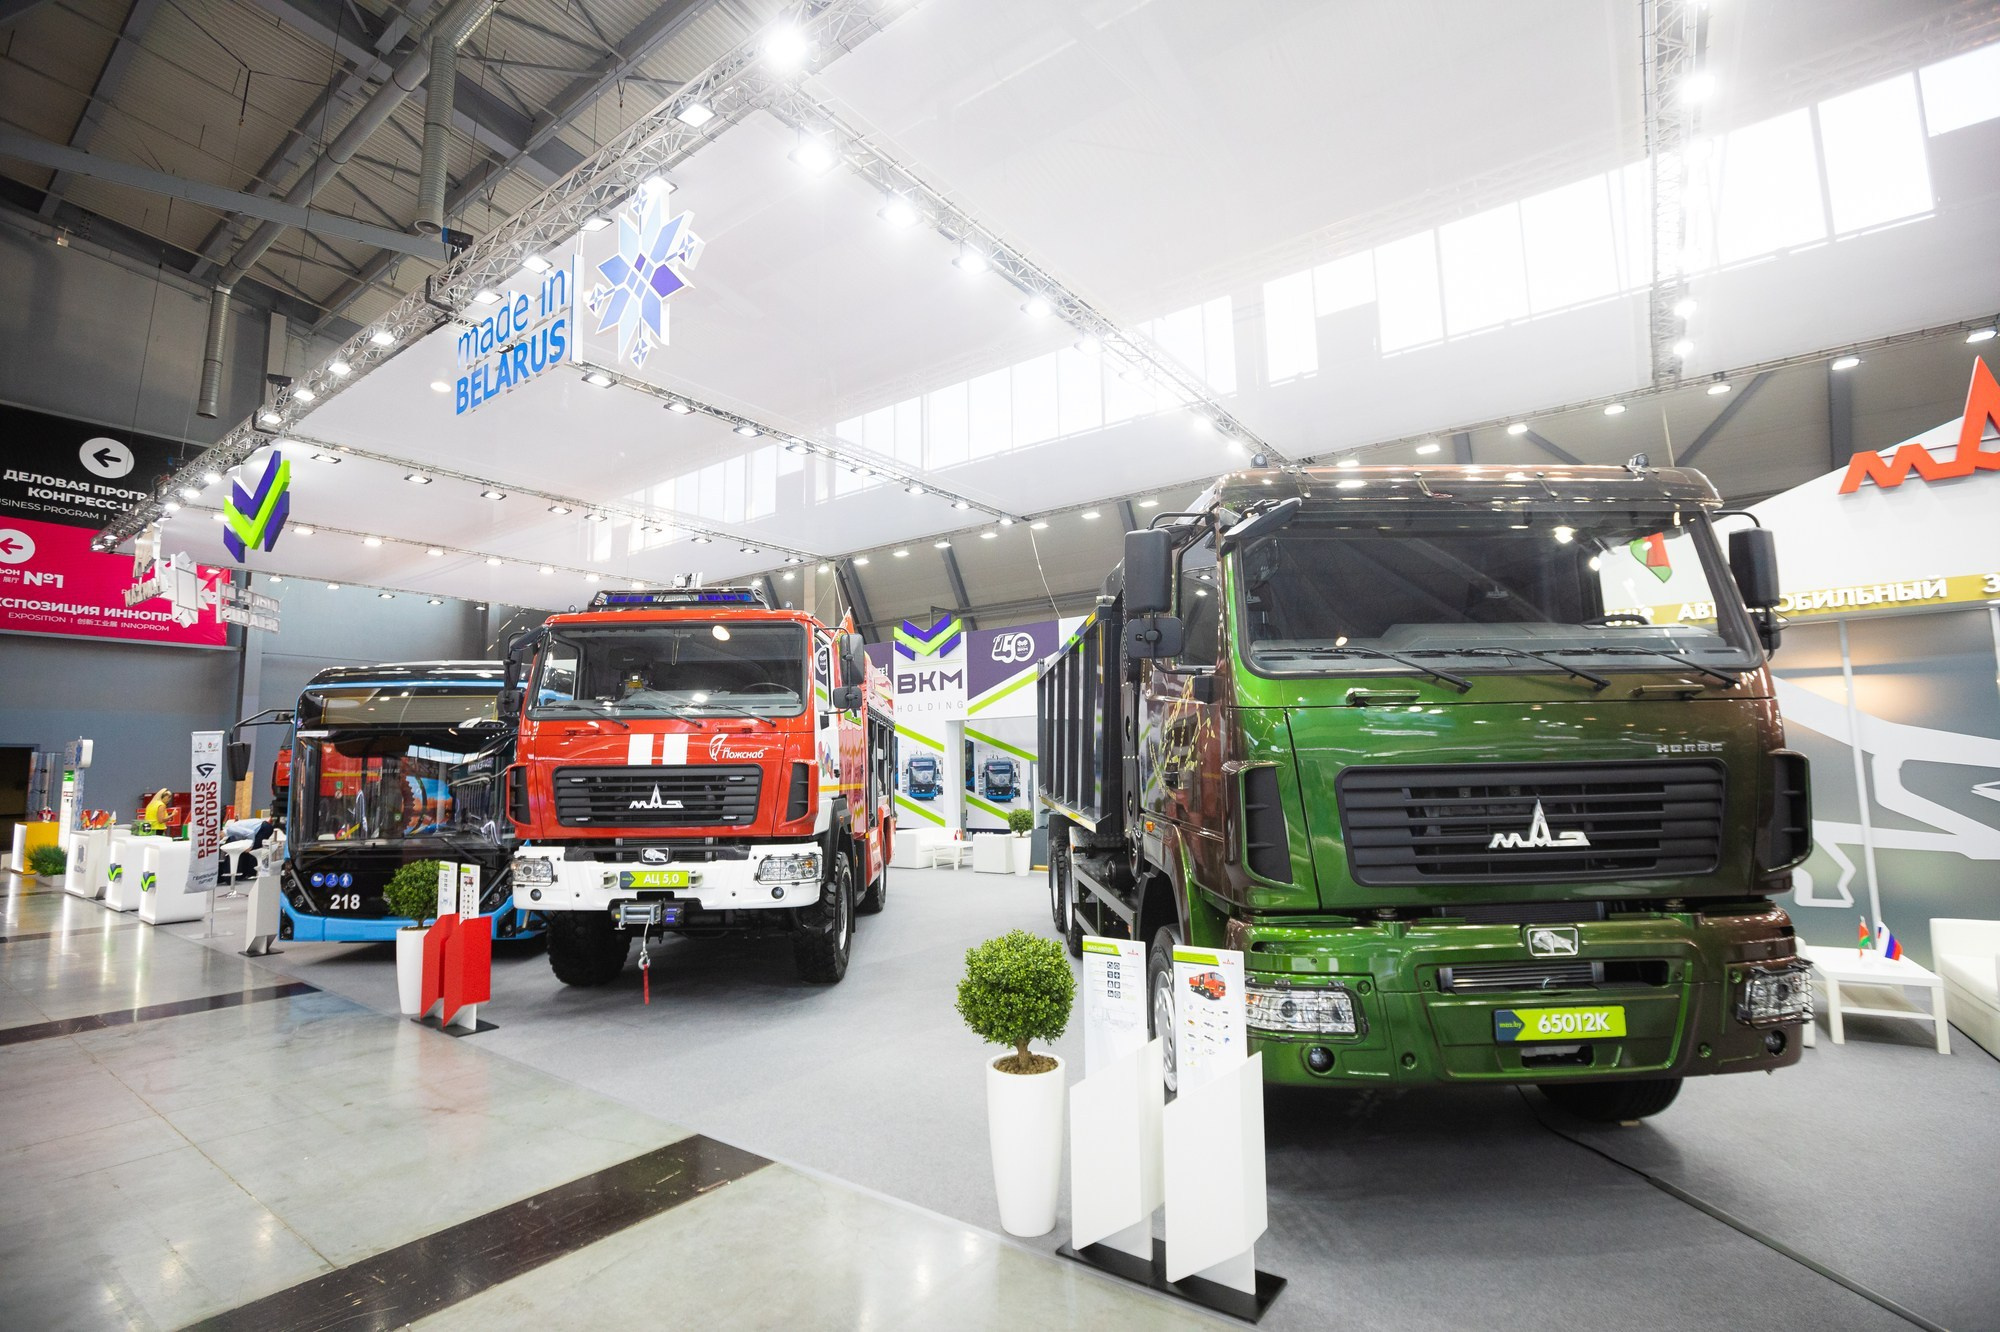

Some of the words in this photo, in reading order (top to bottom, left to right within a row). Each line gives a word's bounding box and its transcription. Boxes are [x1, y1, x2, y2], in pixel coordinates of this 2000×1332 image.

[457, 290, 528, 368] made
[541, 269, 566, 317] in
[456, 319, 566, 415] BELARUS
[3, 469, 90, 492] ДЕЛОВАЯ
[43, 504, 99, 520] PROGRAM
[23, 571, 64, 589] №1
[8, 611, 66, 623] EXPOSITION
[120, 622, 170, 632] INNOPROM
[897, 668, 962, 694] BKM
[896, 700, 964, 712] HOLDING
[721, 747, 766, 759] Пожснаб
[195, 782, 206, 860] BELARUS
[206, 781, 218, 857] TRACTORS
[643, 874, 660, 885] АЦ
[663, 874, 679, 885] 5,0
[330, 894, 361, 910] 218
[1538, 1012, 1610, 1034] 65012K
